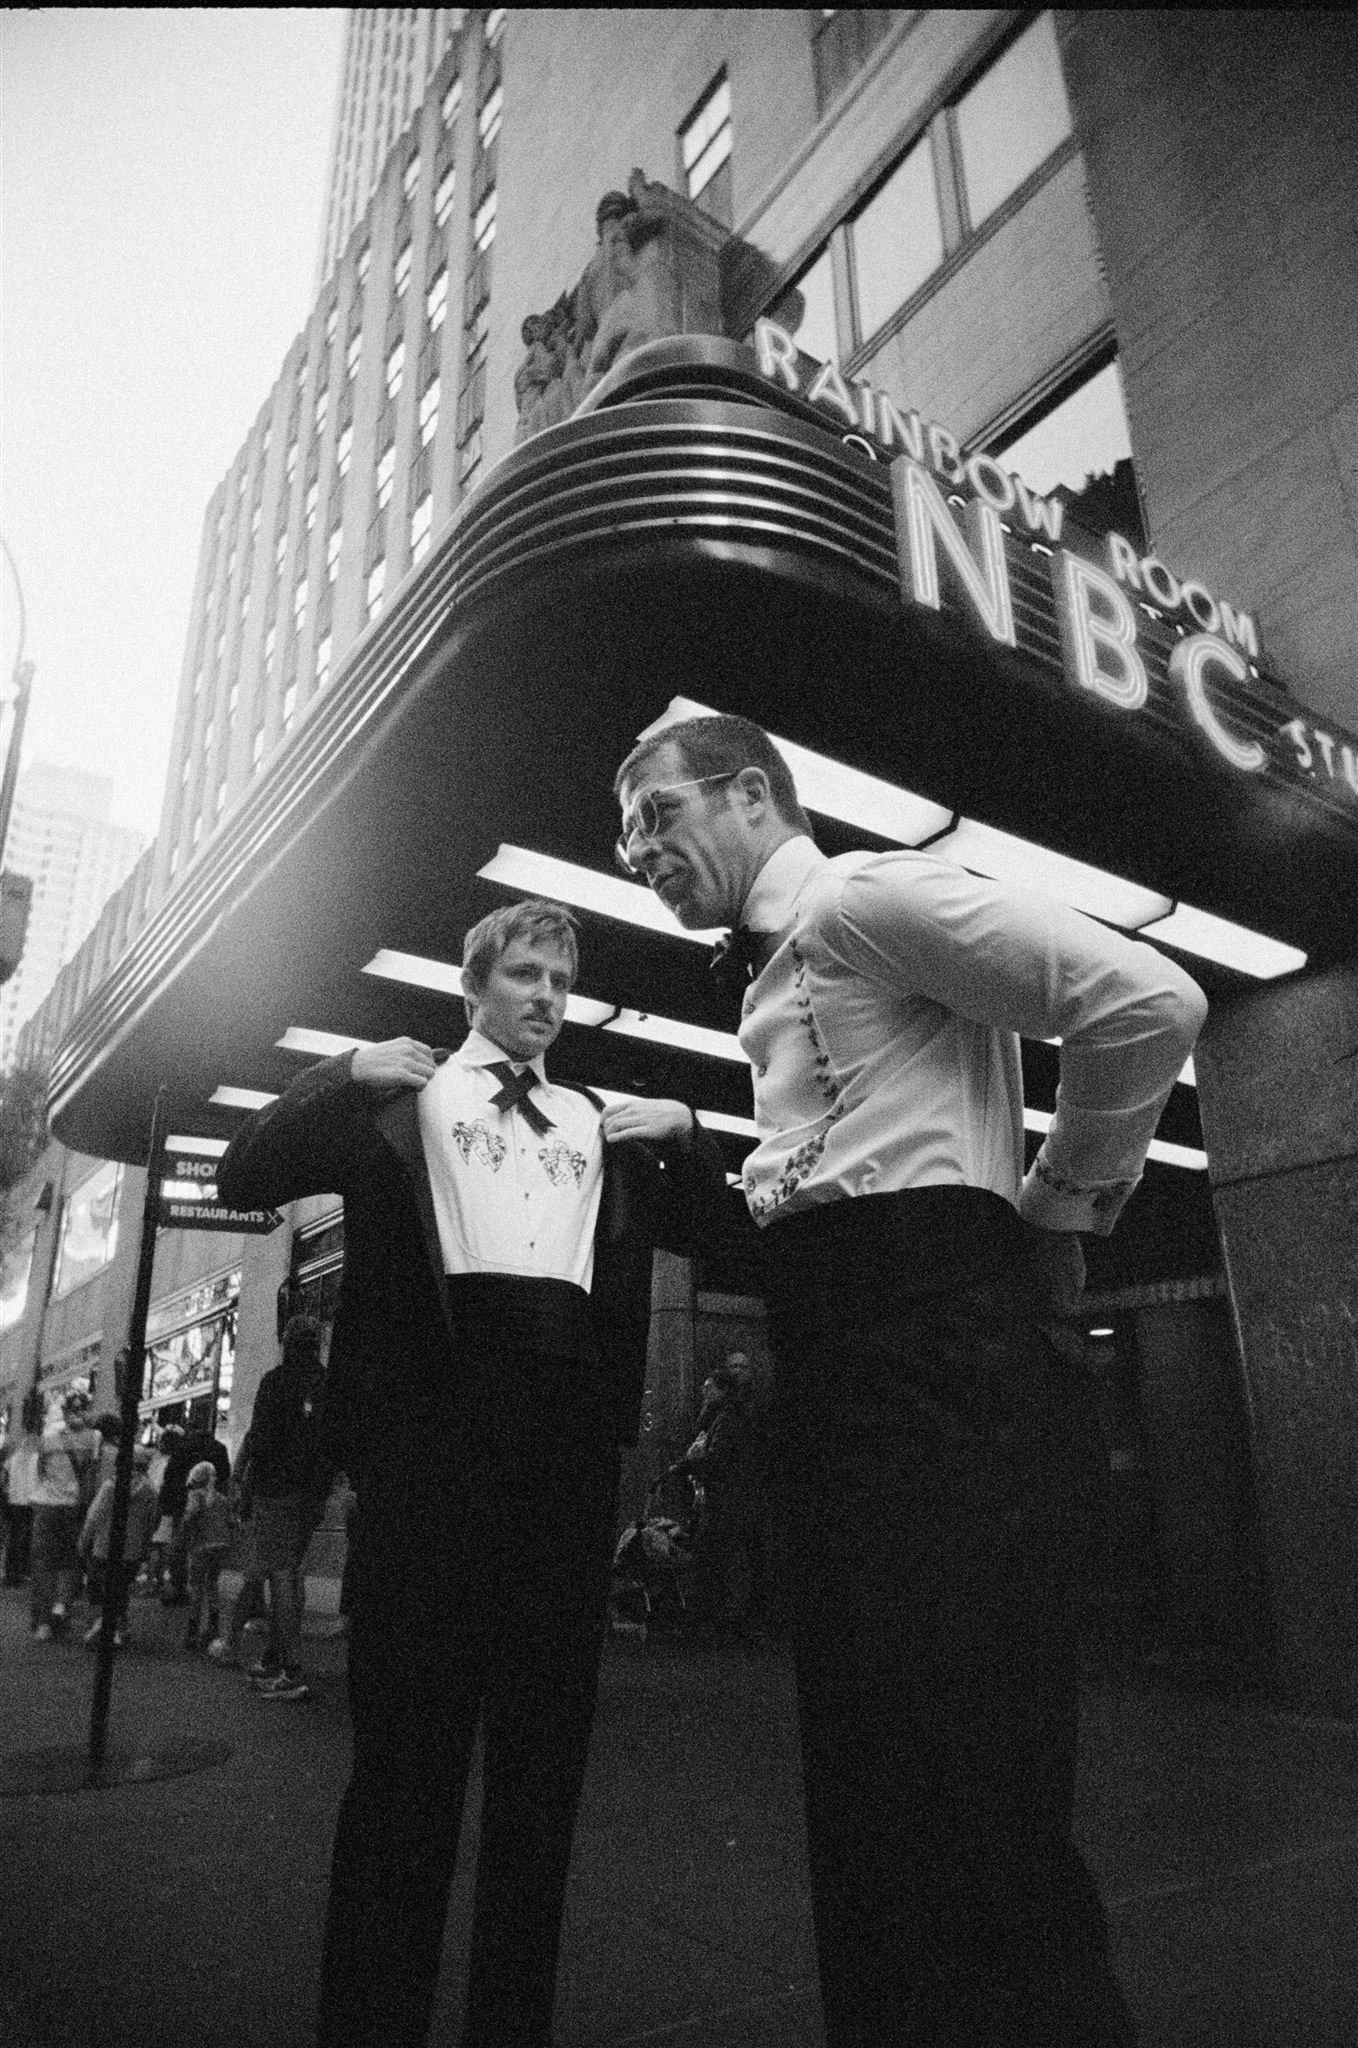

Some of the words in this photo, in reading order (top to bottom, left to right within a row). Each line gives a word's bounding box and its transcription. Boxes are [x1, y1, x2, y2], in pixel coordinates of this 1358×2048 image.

[755, 317, 1064, 541] RAINBOW
[1106, 531, 1258, 658] ROOM
[891, 455, 1264, 769] NBC
[170, 1204, 264, 1222] RESTAURANTS
